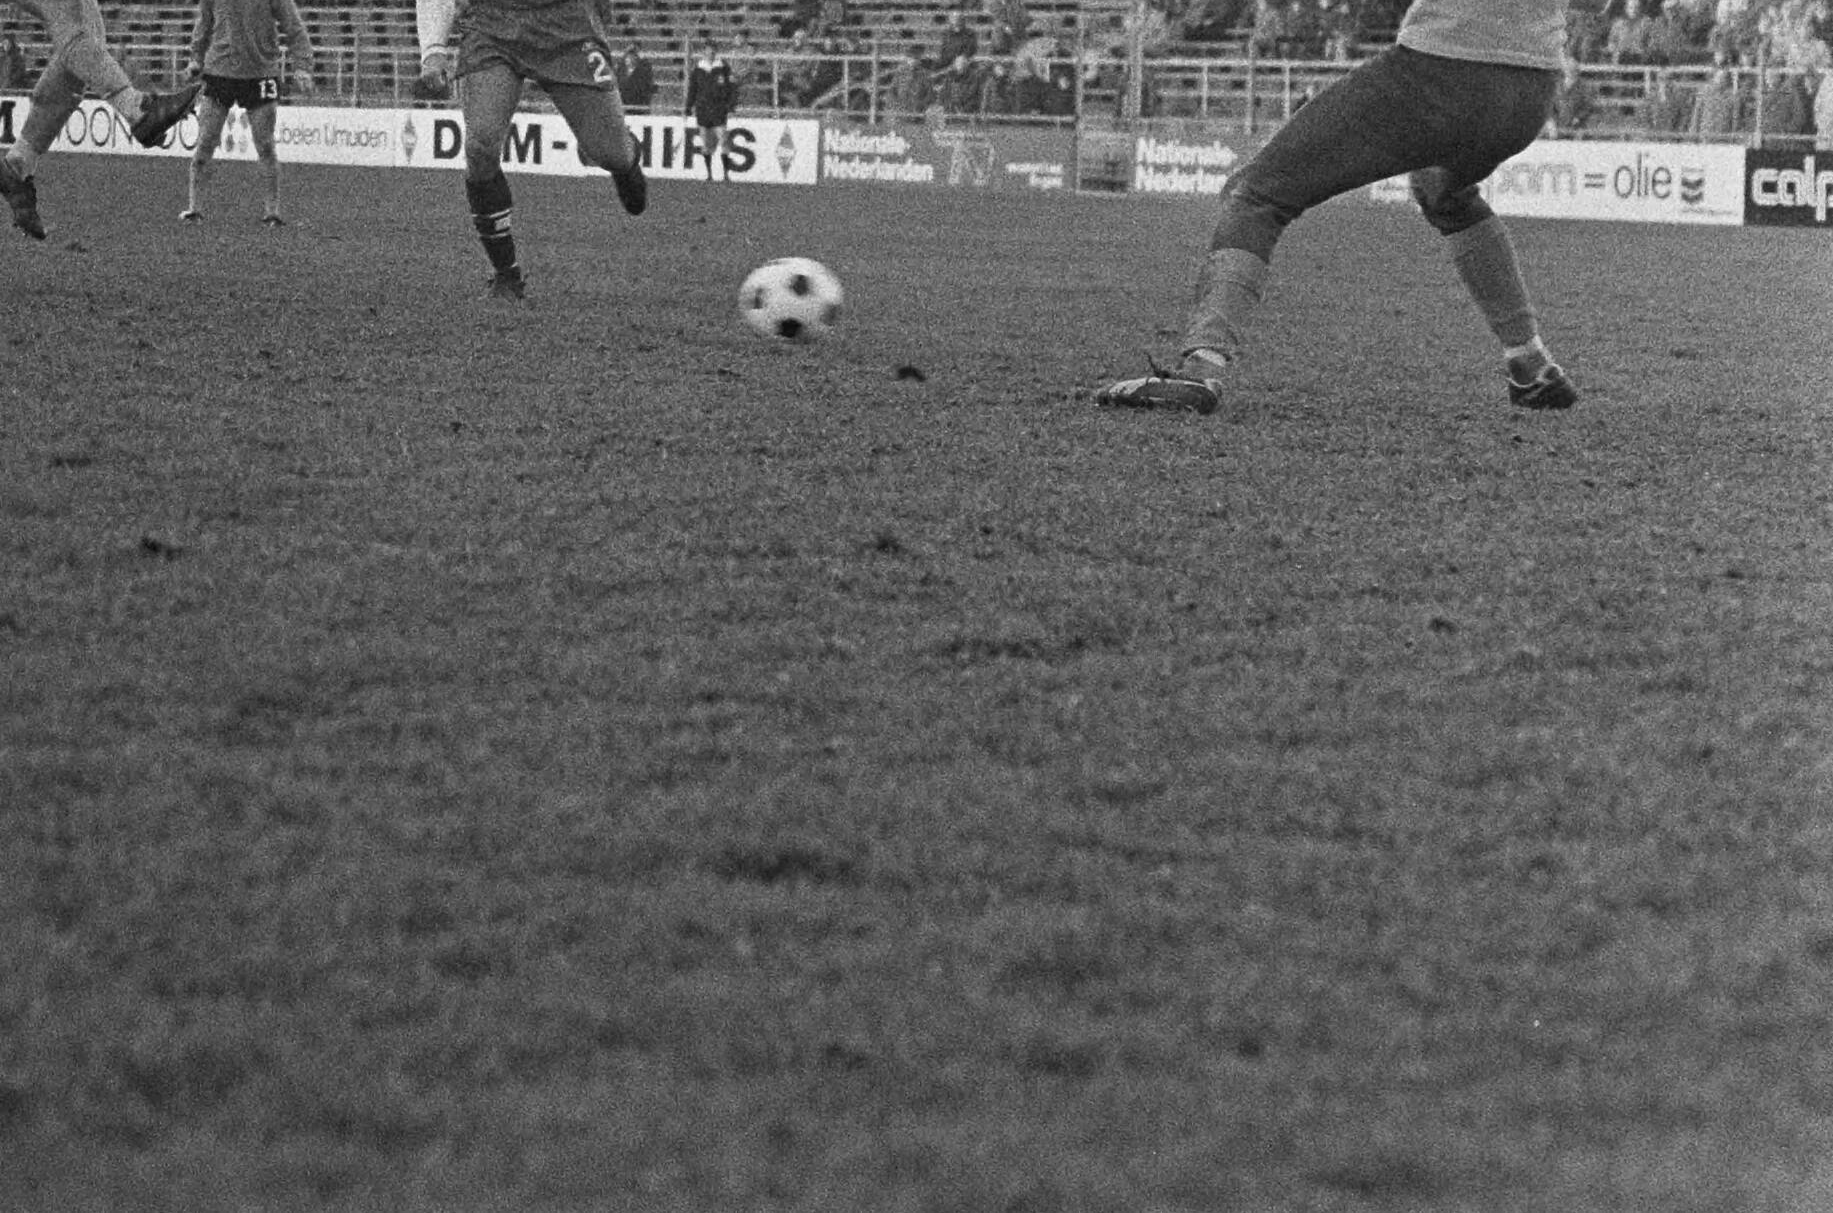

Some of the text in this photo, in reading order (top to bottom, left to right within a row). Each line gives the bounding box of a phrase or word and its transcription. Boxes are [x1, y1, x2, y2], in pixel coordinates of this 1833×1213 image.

[587, 51, 612, 84] 2
[260, 78, 278, 99] 13
[1614, 151, 1673, 200] olie
